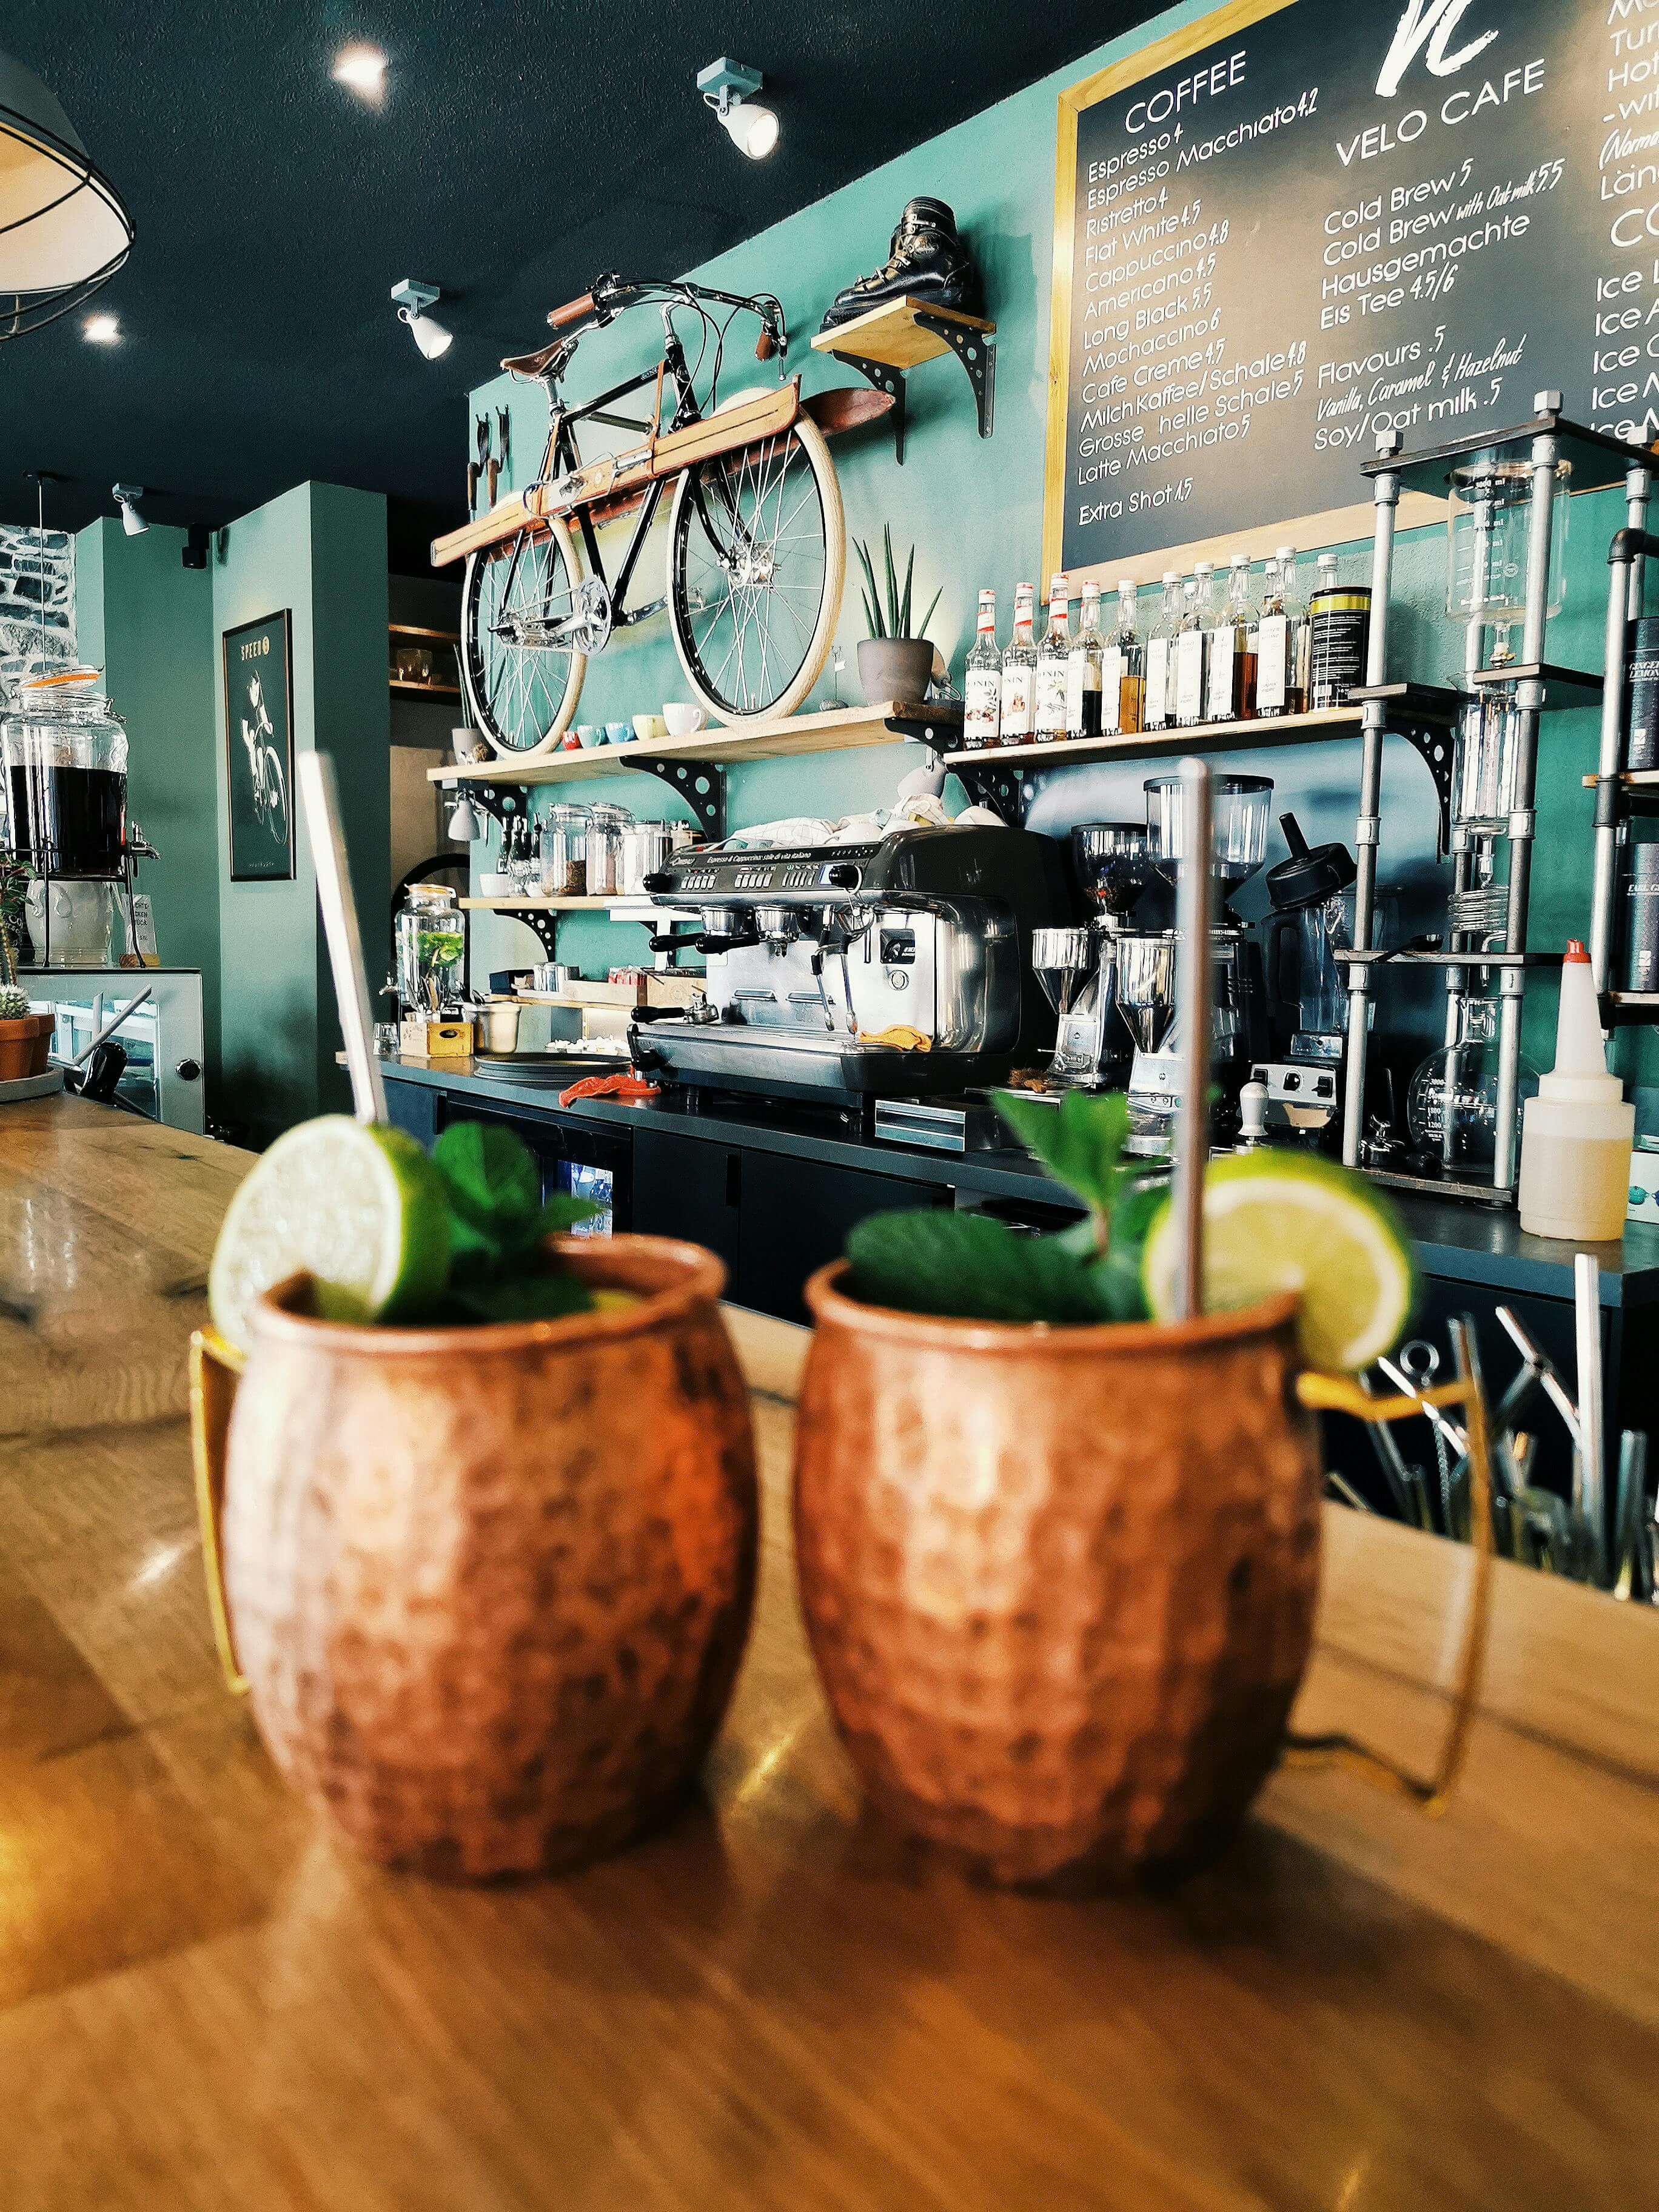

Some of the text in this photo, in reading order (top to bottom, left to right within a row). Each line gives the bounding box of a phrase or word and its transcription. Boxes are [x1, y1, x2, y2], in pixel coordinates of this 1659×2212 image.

[1125, 50, 1247, 133] COFFEE
[1336, 58, 1545, 167] VELO CAFE
[1088, 133, 1171, 183] Espresso
[1088, 161, 1170, 210] Espresso
[1324, 158, 1474, 235] Cold Brew 5
[1601, 164, 1659, 201] Län
[1323, 226, 1381, 266] Cold
[1389, 203, 1456, 244] Brew
[1455, 191, 1484, 221] with
[1085, 237, 1118, 267] Flat
[1322, 215, 1530, 300] Hausgemachte
[1321, 304, 1350, 330] Eis
[1357, 287, 1405, 316] Tee
[1597, 270, 1643, 302] Ice
[1084, 320, 1130, 350] Long
[1135, 295, 1188, 330] Black
[1595, 307, 1642, 337] Ice
[1317, 386, 1363, 422] Vanilla,
[1368, 360, 1436, 406] Caramel
[1454, 333, 1527, 382] Hazelnut
[1318, 342, 1421, 389] Flavours
[1593, 345, 1641, 375] Ice
[1082, 374, 1128, 404] Cafe
[1428, 386, 1477, 421] milk
[1592, 383, 1638, 411] Ice
[1079, 426, 1145, 457] Grosse
[1159, 404, 1210, 435] helle
[1078, 458, 1121, 486] Latte
[1079, 500, 1122, 526] Extra
[1128, 483, 1173, 512] Shot
